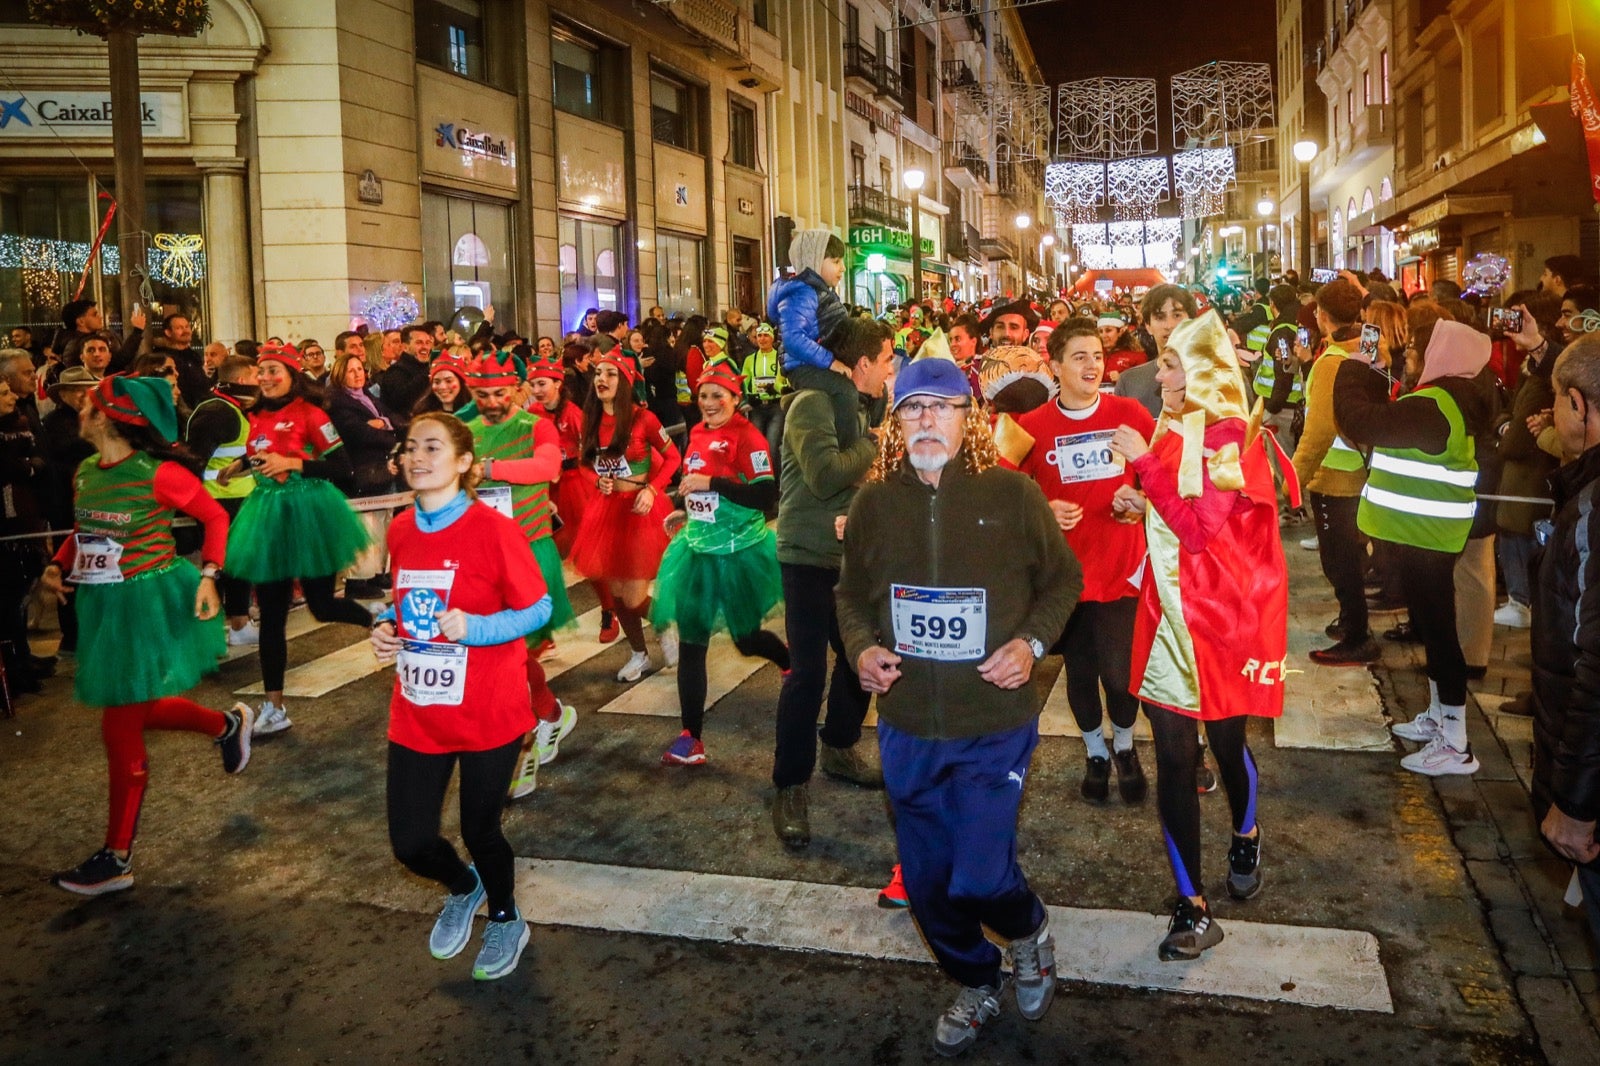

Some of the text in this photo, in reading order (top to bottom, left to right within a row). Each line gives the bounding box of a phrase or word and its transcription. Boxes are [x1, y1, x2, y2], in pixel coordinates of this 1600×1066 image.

[38, 100, 156, 122] CaixaBk
[457, 128, 507, 157] CaixaBank
[853, 228, 882, 244] 16H
[890, 229, 935, 254] FARCIA
[1072, 448, 1114, 470] 640
[910, 613, 968, 641] 599
[403, 663, 455, 688] 1109
